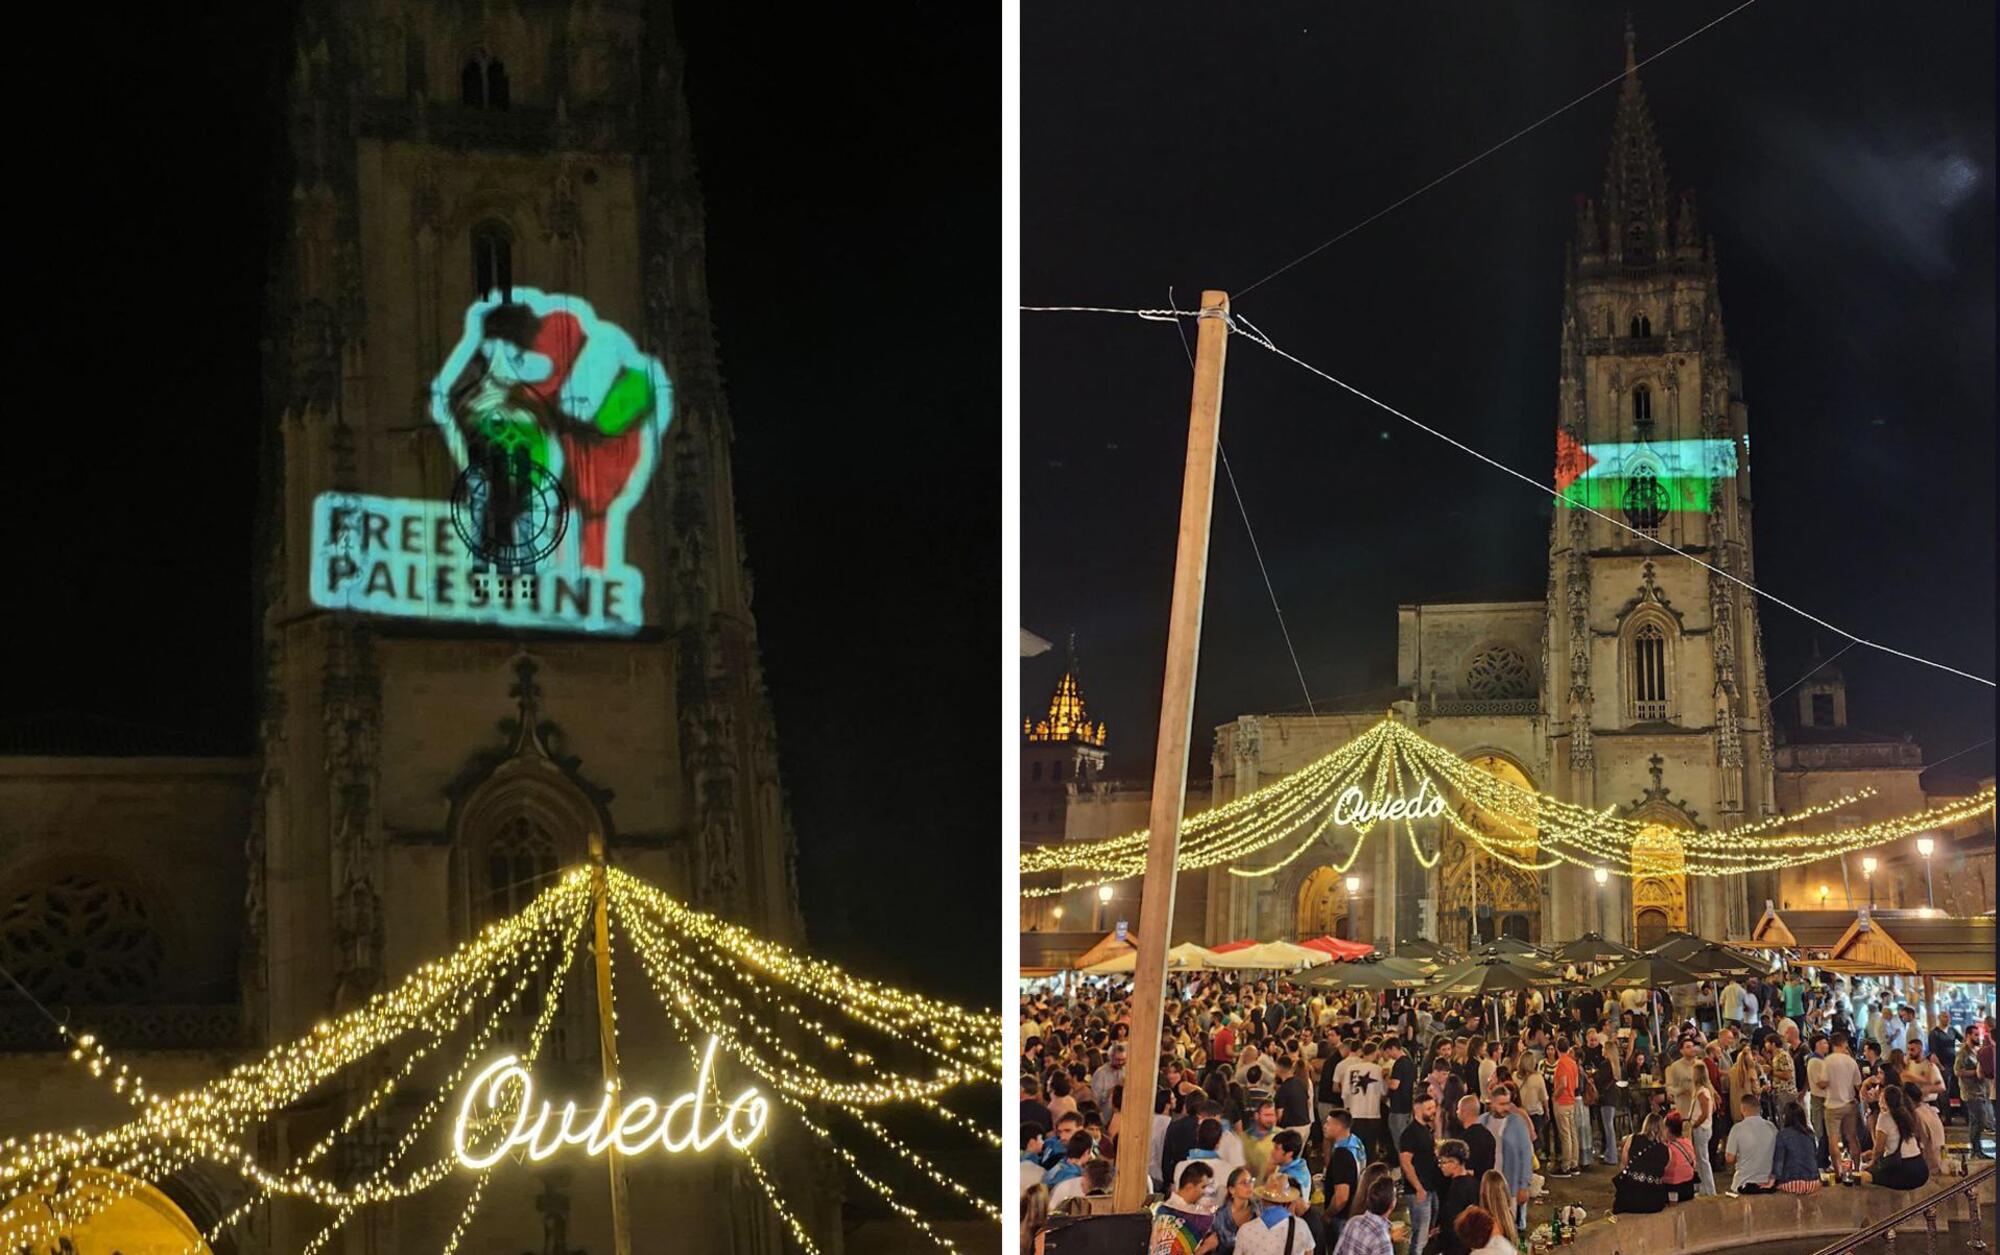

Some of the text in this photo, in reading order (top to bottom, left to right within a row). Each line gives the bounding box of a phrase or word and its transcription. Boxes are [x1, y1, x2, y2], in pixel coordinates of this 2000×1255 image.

[329, 506, 455, 556] FREE
[1334, 778, 1446, 826] Oviedo
[455, 1034, 767, 1169] Oviedo
